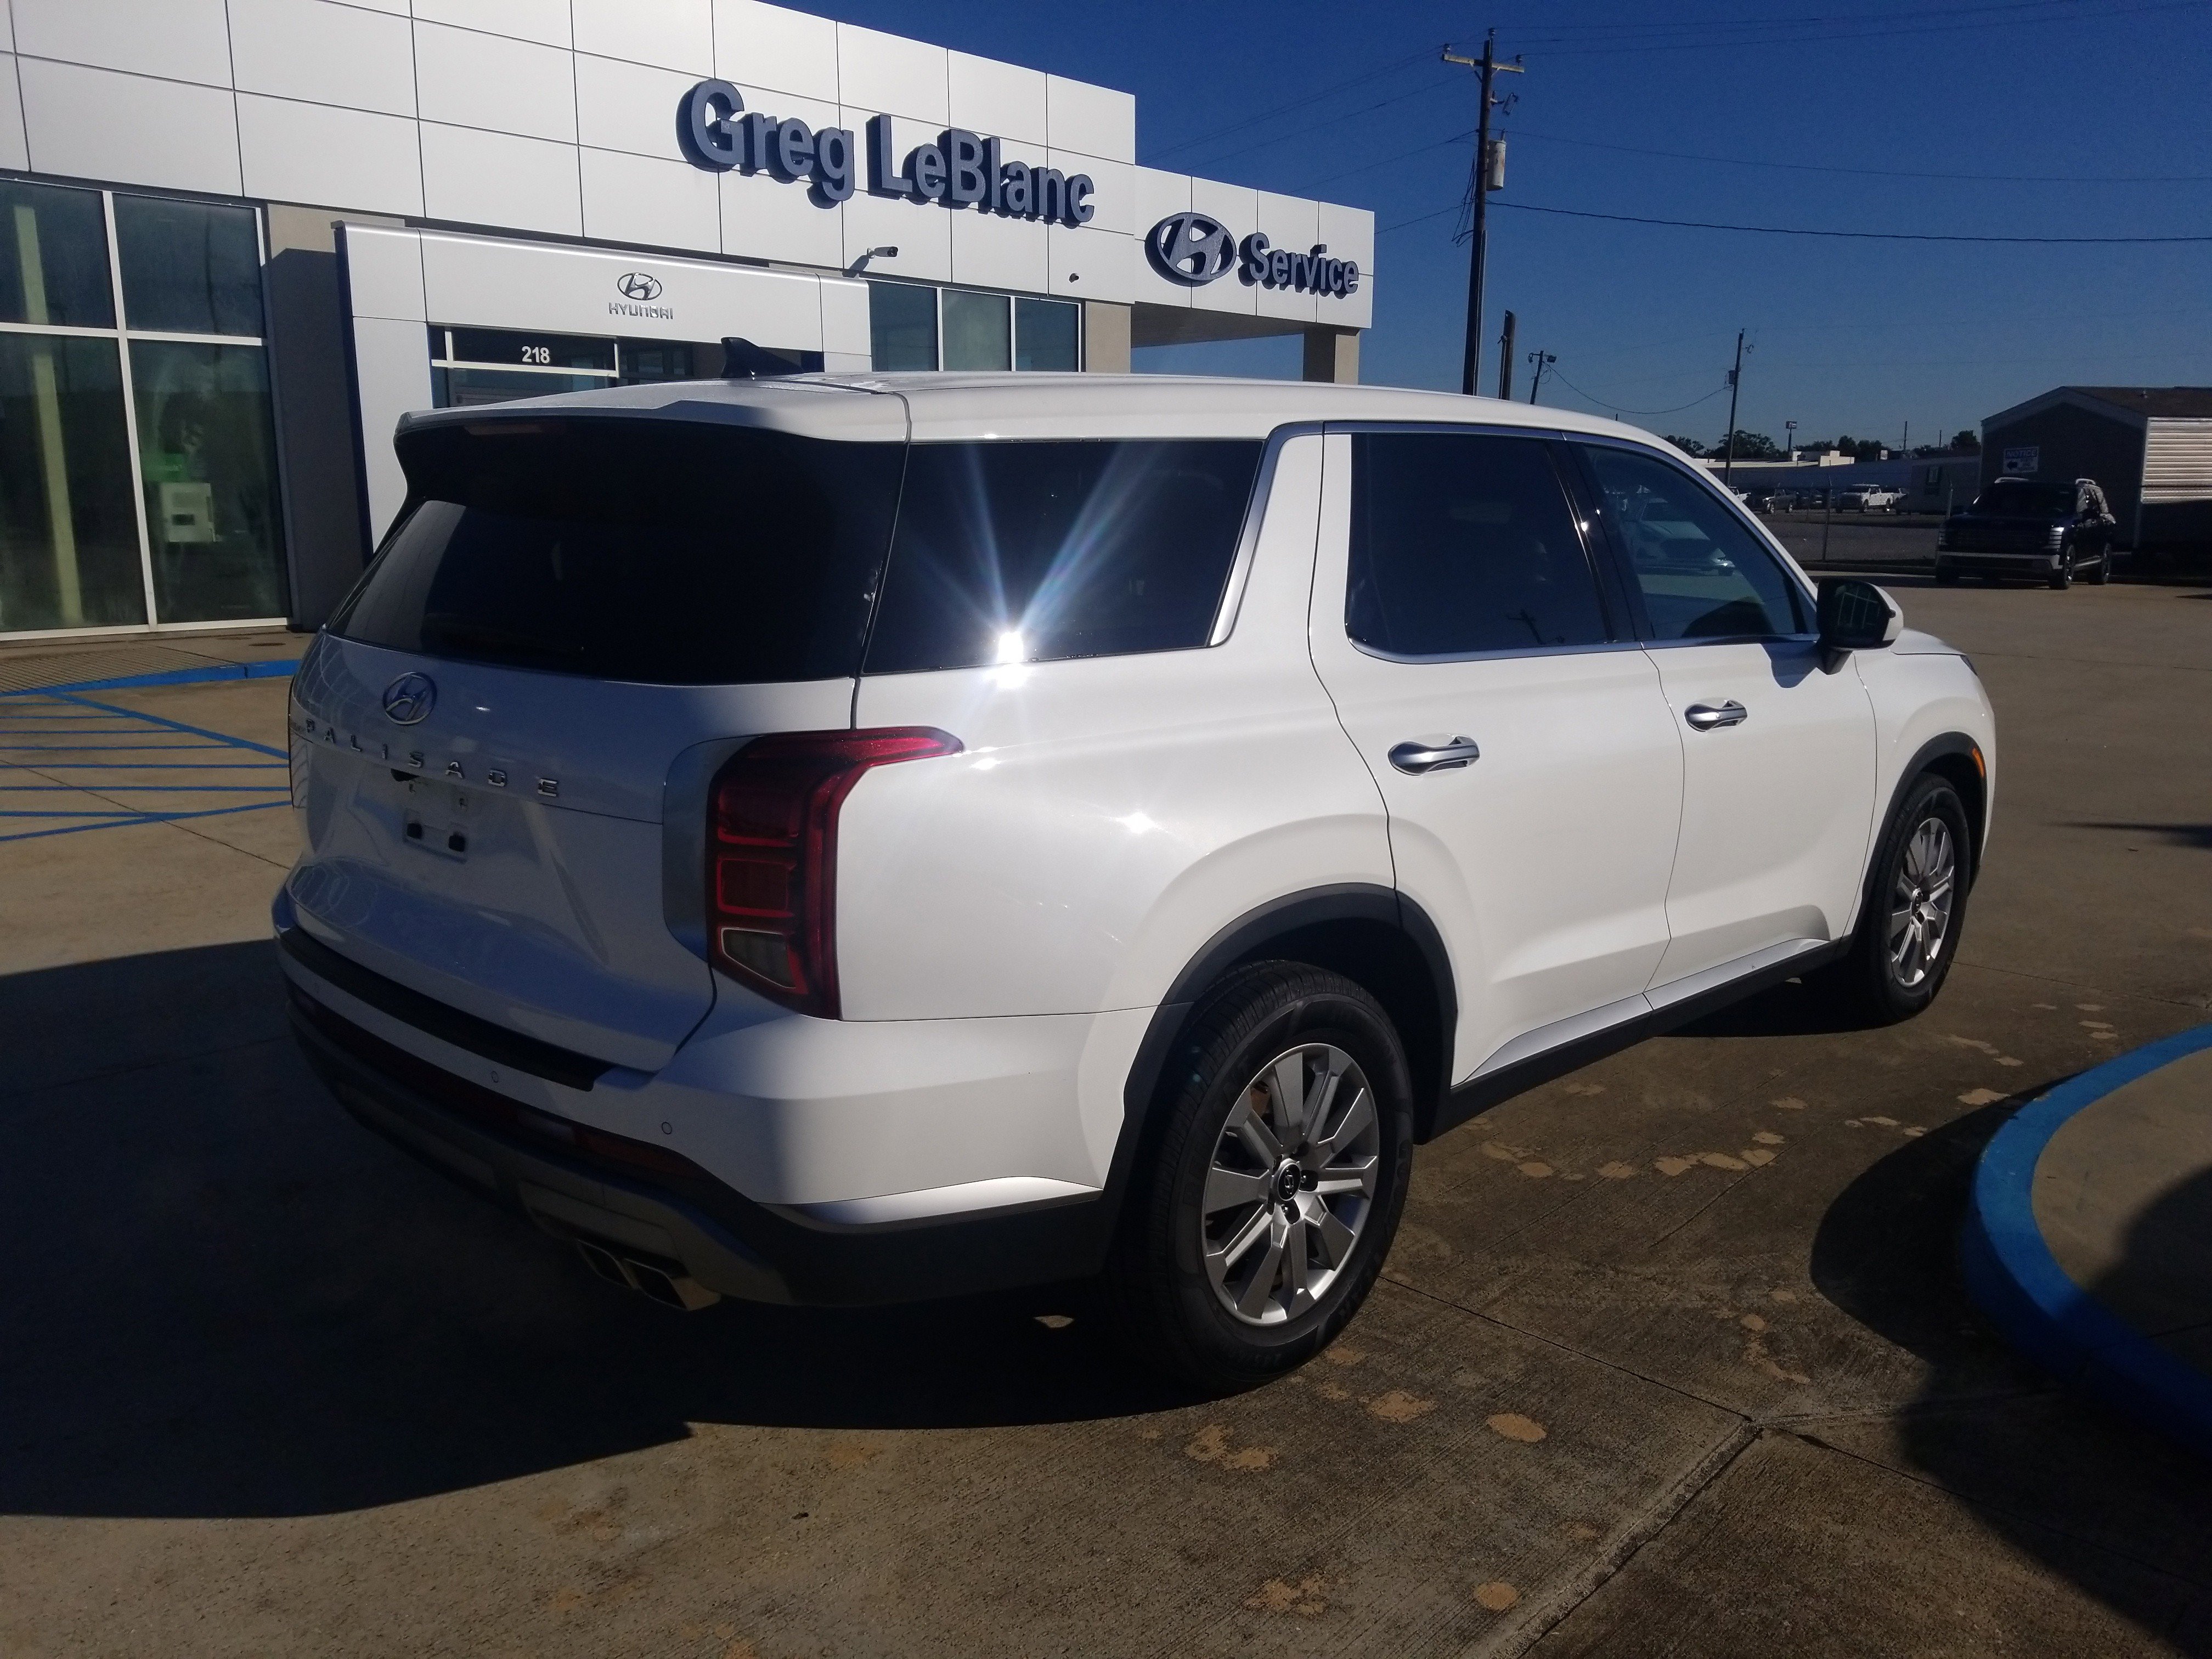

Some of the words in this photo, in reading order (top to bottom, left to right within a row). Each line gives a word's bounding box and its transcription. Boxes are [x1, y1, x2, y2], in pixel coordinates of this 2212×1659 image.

[676, 79, 855, 209] Greg
[866, 114, 1095, 229] LeBlanc
[1238, 232, 1359, 299] Service
[608, 302, 673, 320] HYUNDAI
[522, 346, 550, 364] 218
[2006, 449, 2036, 458] NOTICE
[306, 718, 558, 798] PALISADE
